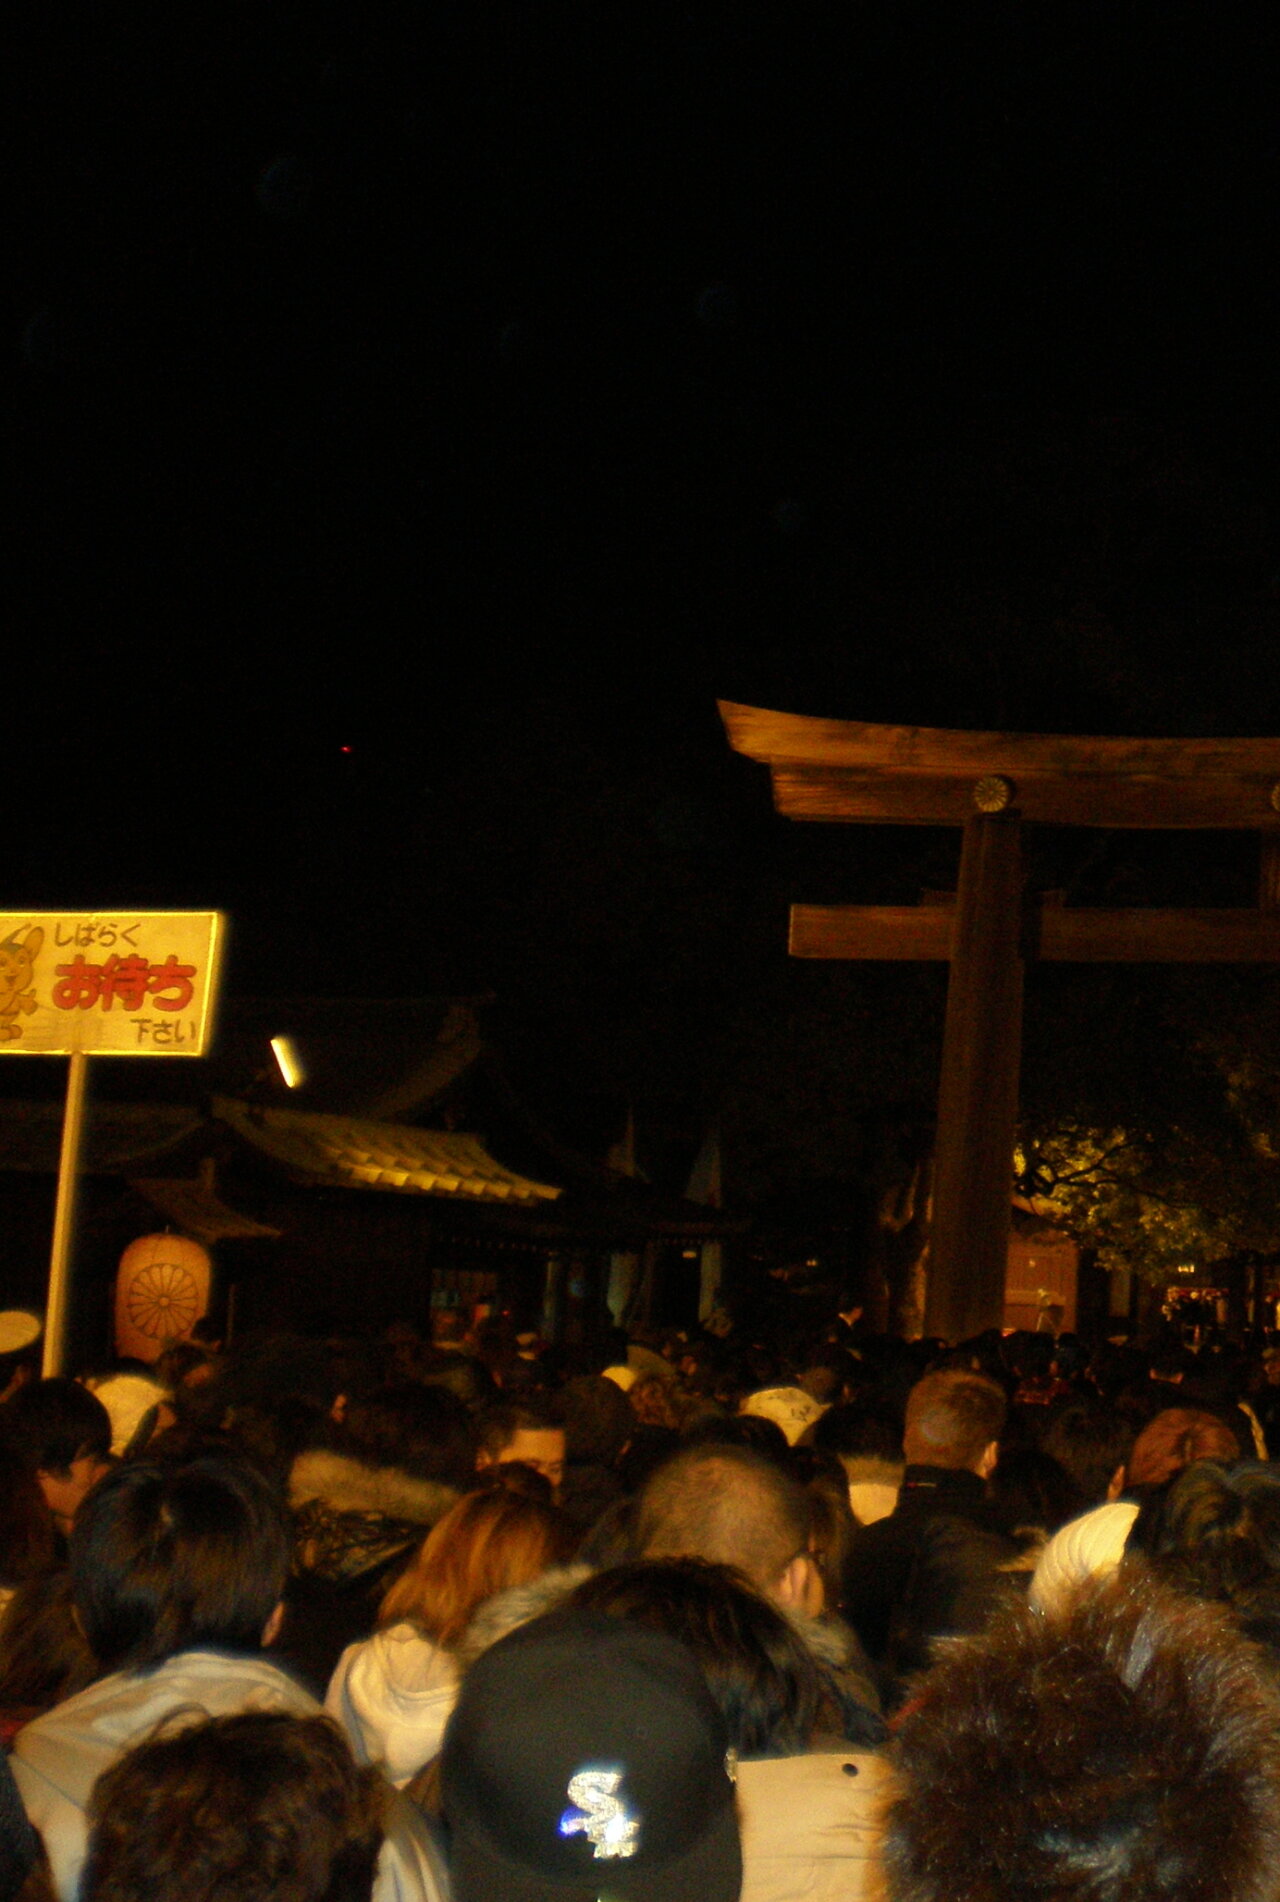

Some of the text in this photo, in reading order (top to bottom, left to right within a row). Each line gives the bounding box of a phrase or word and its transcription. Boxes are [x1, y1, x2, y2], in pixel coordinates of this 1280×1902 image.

[54, 922, 141, 948] しばらく
[52, 953, 197, 1013] お待ち
[130, 1018, 197, 1044] 下さい
